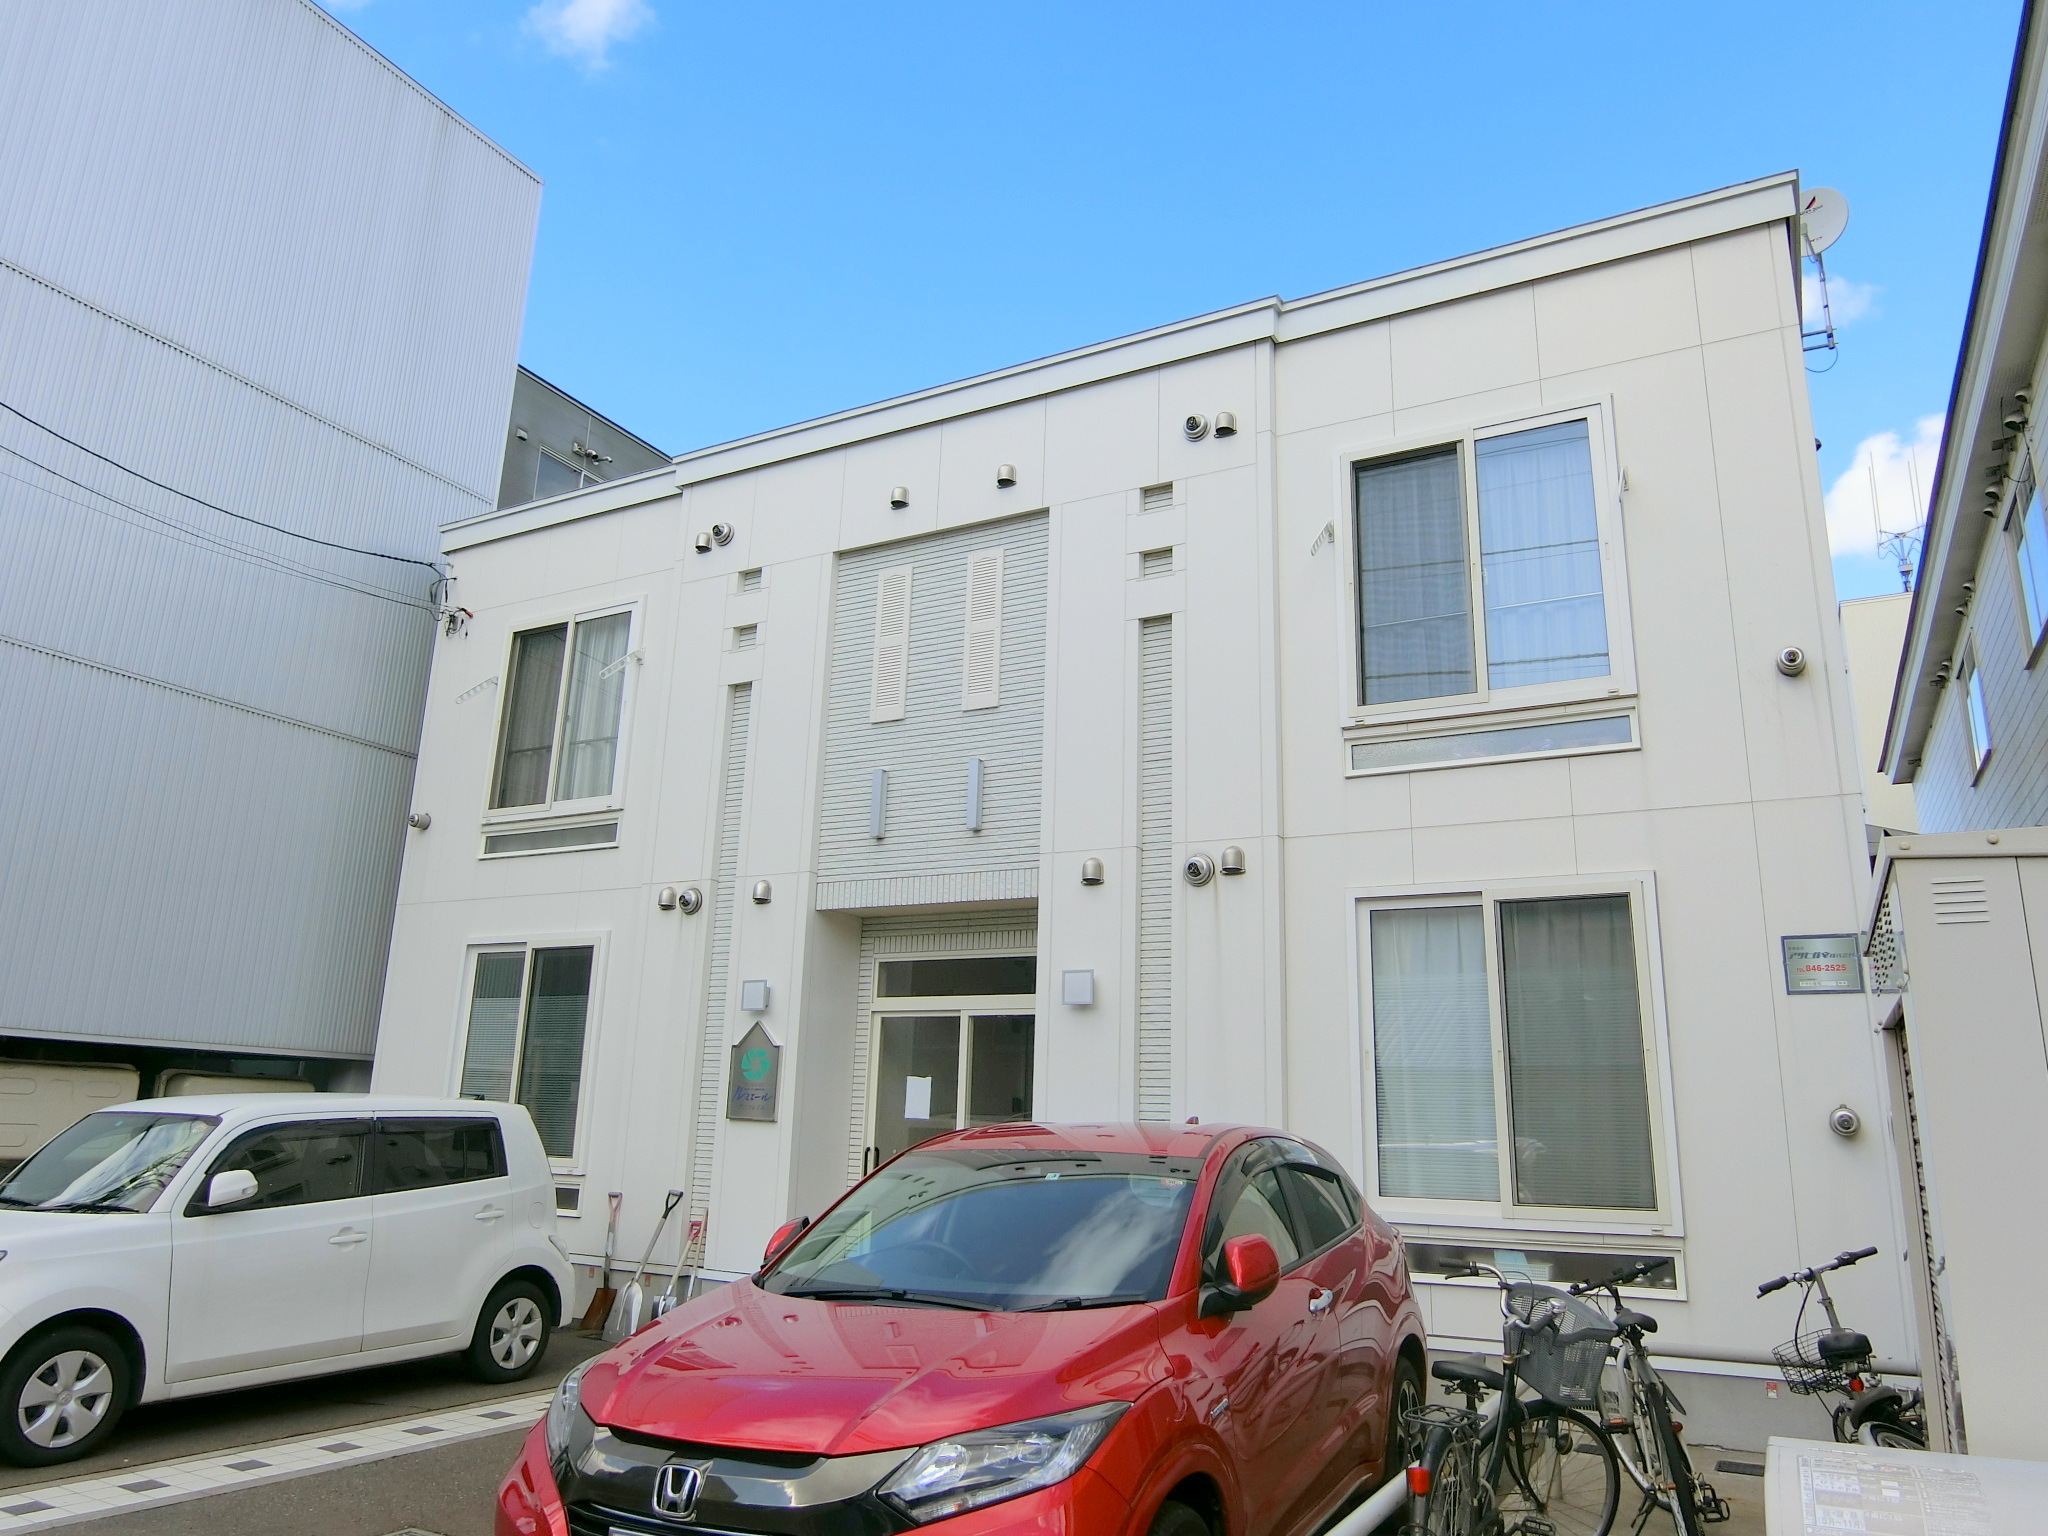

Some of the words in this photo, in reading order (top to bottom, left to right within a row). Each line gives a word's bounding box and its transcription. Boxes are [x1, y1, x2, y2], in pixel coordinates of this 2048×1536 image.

[1805, 964, 1847, 972] 846-2525
[733, 1086, 773, 1101] ルミエール
